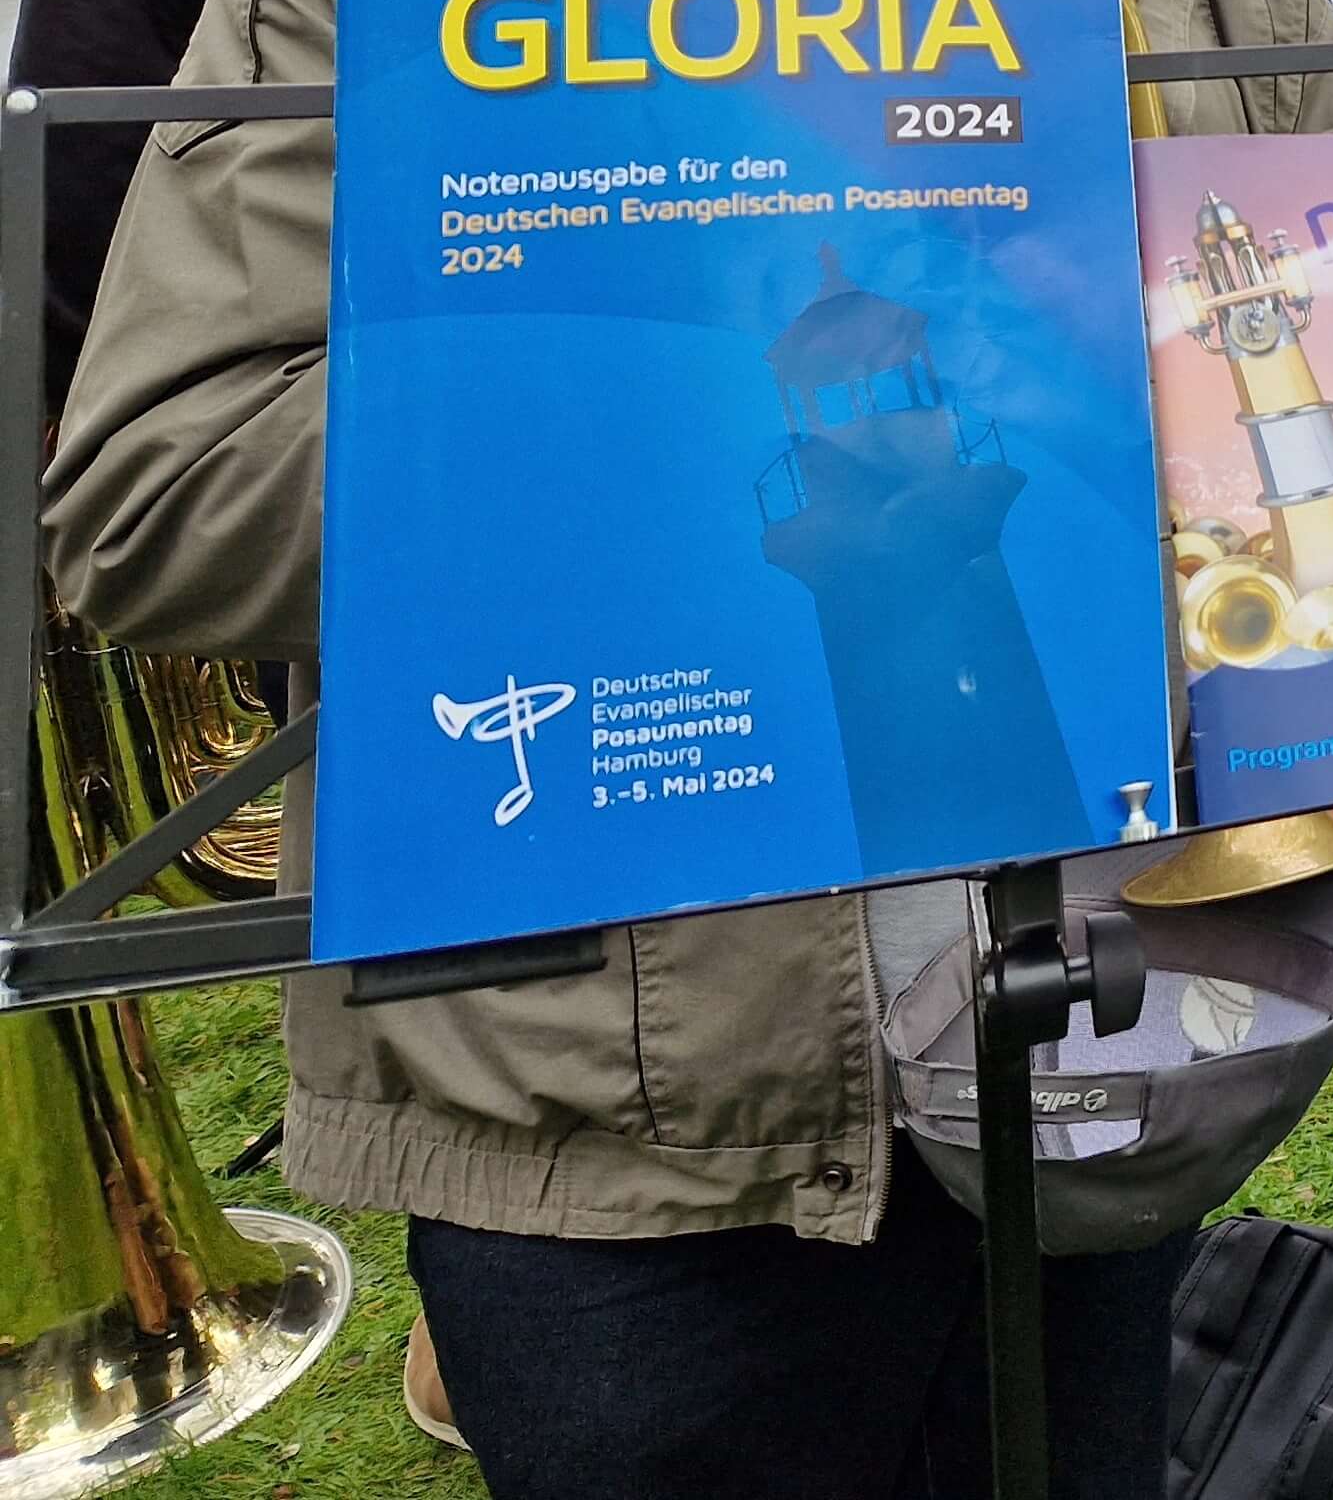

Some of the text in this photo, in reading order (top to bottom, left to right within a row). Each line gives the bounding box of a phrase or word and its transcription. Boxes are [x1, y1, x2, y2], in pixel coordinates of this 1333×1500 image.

[894, 103, 1013, 138] 2024
[442, 155, 788, 198] Notenausgabe für den
[441, 183, 1028, 237] Deutschen Evangelischen Posaunentag
[441, 243, 524, 275] 2024
[592, 668, 713, 699] Deutscher
[592, 688, 752, 725] Evangelischer
[592, 714, 753, 750] Posaunentag
[592, 746, 702, 777] Hamburg
[662, 772, 706, 799] Mai
[712, 763, 775, 792] 2024
